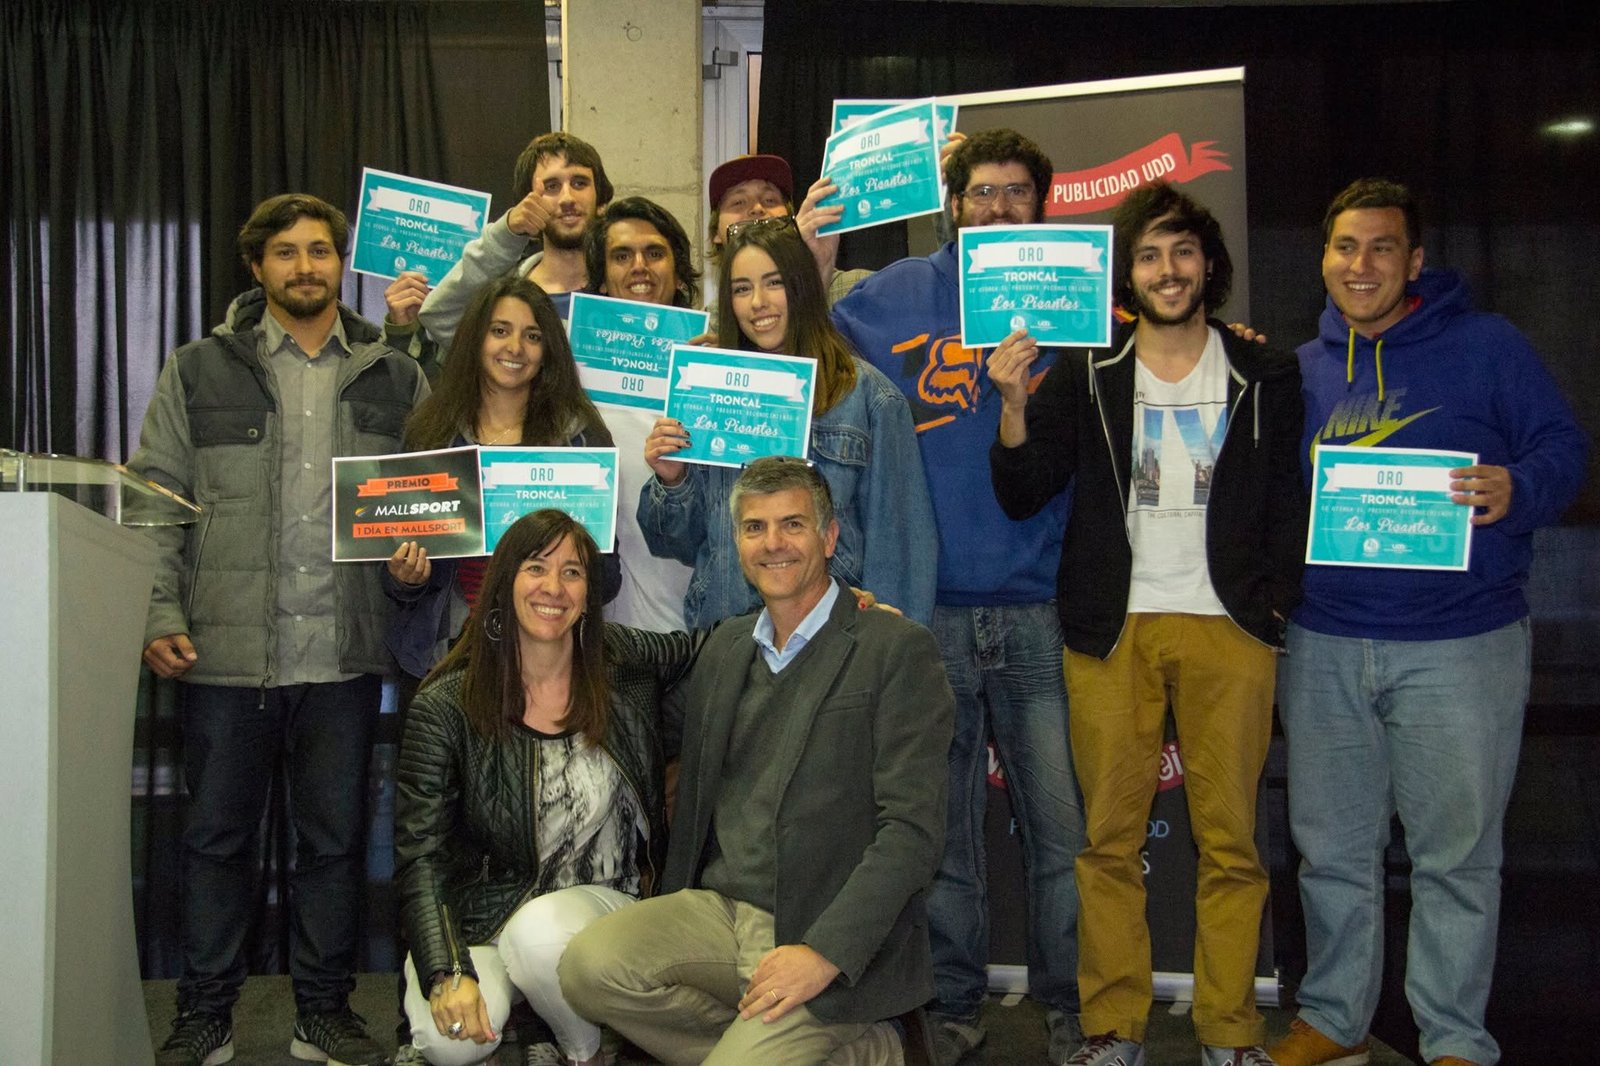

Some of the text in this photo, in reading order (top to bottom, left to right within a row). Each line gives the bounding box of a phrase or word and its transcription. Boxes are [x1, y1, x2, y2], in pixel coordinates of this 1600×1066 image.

[860, 133, 880, 150] ORO
[849, 152, 893, 170] TRONCAL
[839, 171, 913, 199] Los Picantes
[1053, 153, 1176, 204] PUBLICIDAD UDD
[409, 198, 430, 214] ORO
[395, 216, 439, 234] TRONCAL
[380, 235, 455, 261] Los Picantes
[1018, 247, 1043, 262] ORO
[1003, 271, 1059, 282] TRONCAL
[991, 294, 1079, 311] Los Picantes
[611, 356, 660, 372] TRONCAL
[621, 376, 644, 392] ORO
[725, 371, 750, 387] ORO
[709, 393, 762, 408] TRONCAL
[1322, 387, 1408, 440] NIKE
[693, 414, 778, 437] Los Picantes
[530, 467, 554, 481] ORO
[1377, 470, 1403, 485] ORO
[387, 478, 431, 489] PREMIO
[516, 490, 567, 500] TRONCAL
[1360, 494, 1417, 506] TRONCAL
[375, 500, 461, 517] MALLSPORT
[385, 526, 399, 534] EN
[401, 522, 462, 534] MALLSPORT
[1344, 516, 1437, 534] Los Picantes
